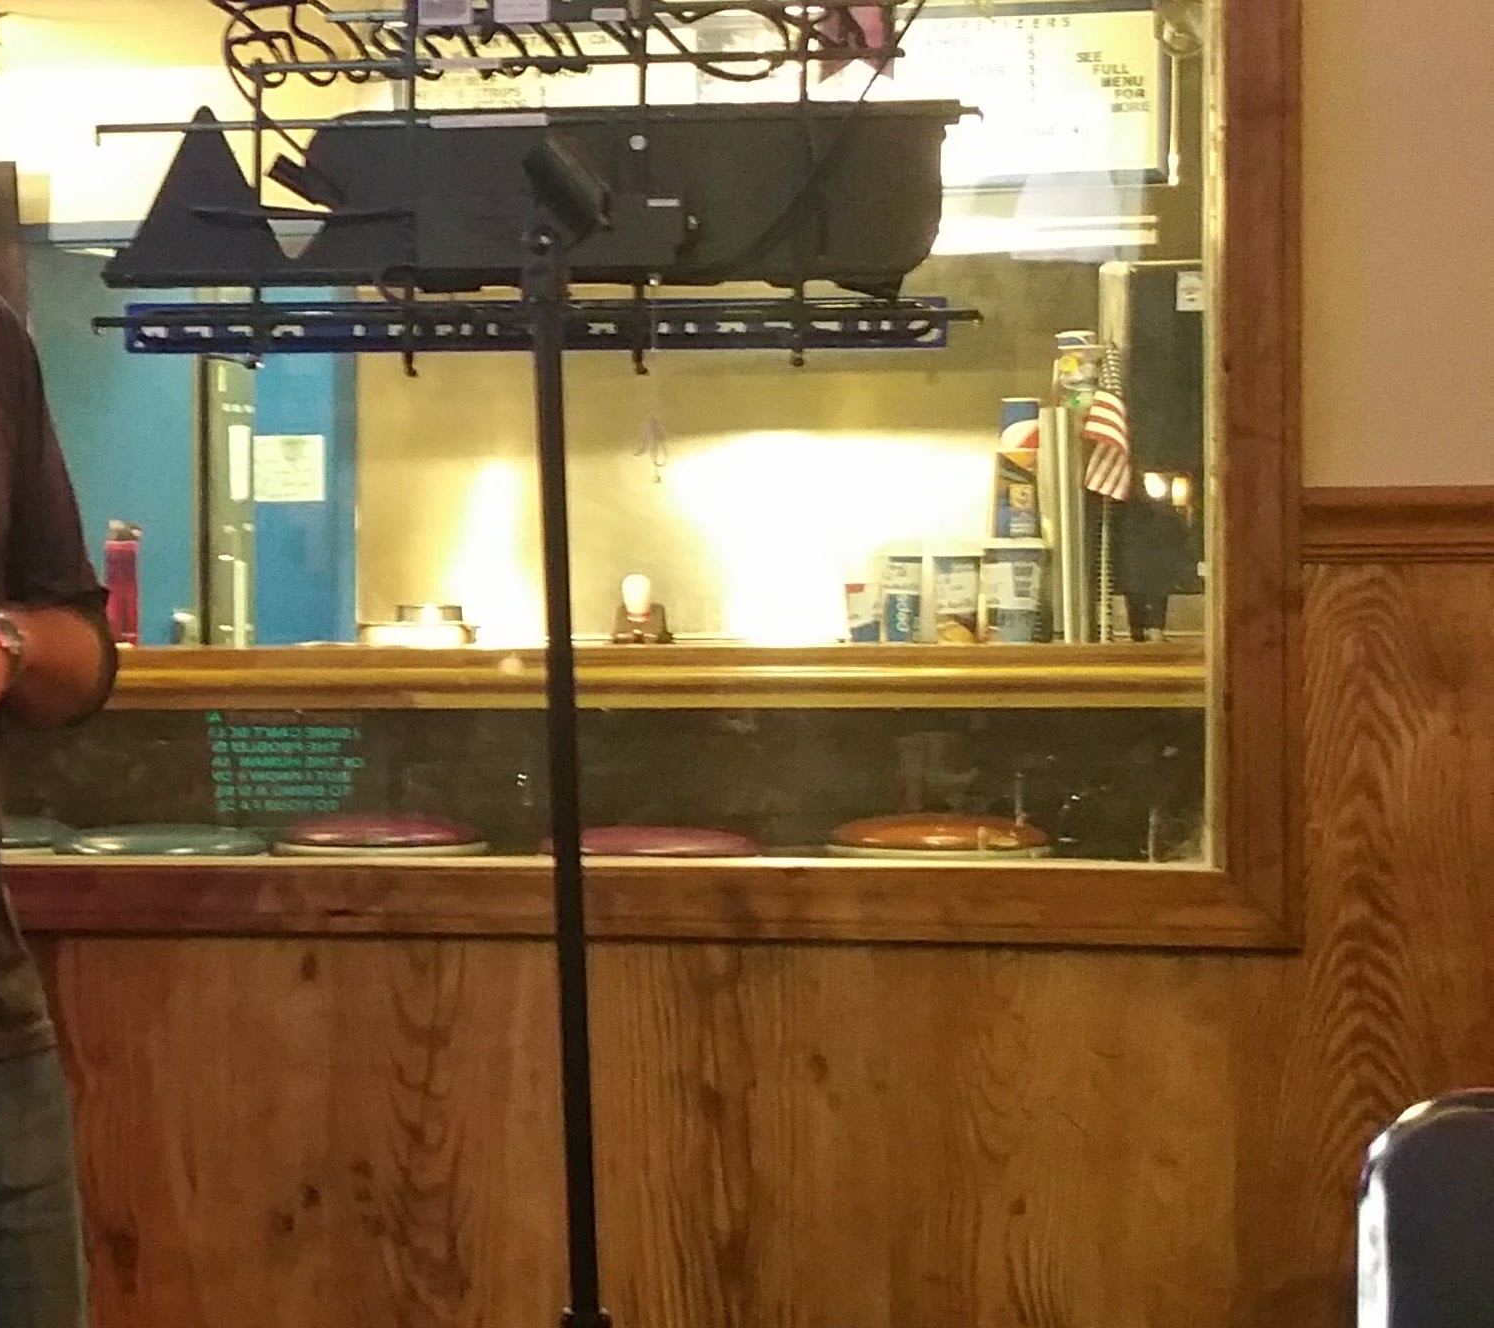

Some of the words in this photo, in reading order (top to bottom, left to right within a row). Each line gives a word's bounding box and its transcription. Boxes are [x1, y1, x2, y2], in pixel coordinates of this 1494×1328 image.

[1075, 51, 1103, 63] SEE
[1092, 63, 1131, 75] FULL
[1100, 75, 1145, 88] MENU
[1114, 88, 1147, 99] FOR
[1110, 100, 1151, 113] MORE
